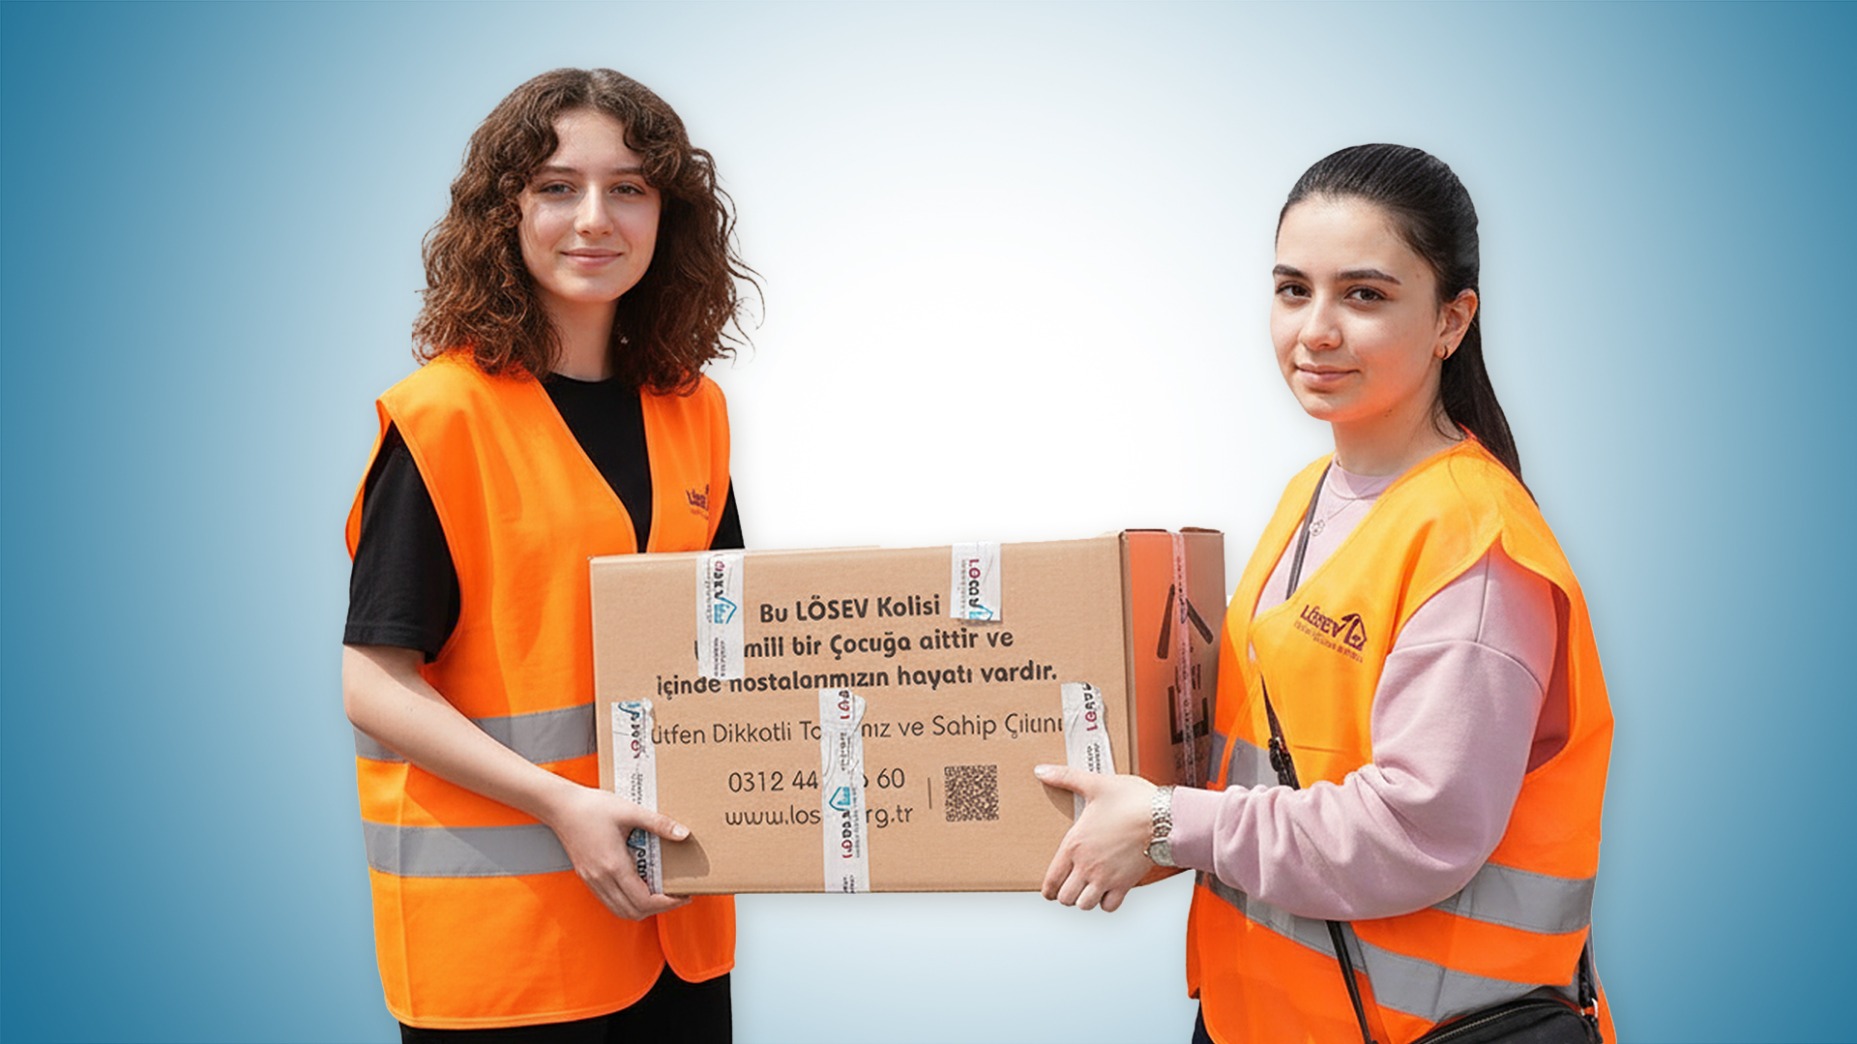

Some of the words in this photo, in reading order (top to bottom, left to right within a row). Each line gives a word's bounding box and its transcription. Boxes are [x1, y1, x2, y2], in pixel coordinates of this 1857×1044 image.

[760, 603, 788, 623] Bu
[795, 594, 869, 622] LÖSEV
[877, 593, 940, 618] Kolisi
[792, 634, 822, 656] bir
[829, 631, 912, 661] Çocuğa
[919, 627, 979, 651] aittir
[986, 631, 1014, 648] ve
[897, 664, 973, 691] hayatı
[980, 659, 1057, 683] vardır.
[651, 723, 706, 745] ütfen
[897, 721, 924, 737] ve
[932, 714, 997, 741] Sahip
[728, 770, 784, 793] 0312
[876, 767, 905, 789] 60
